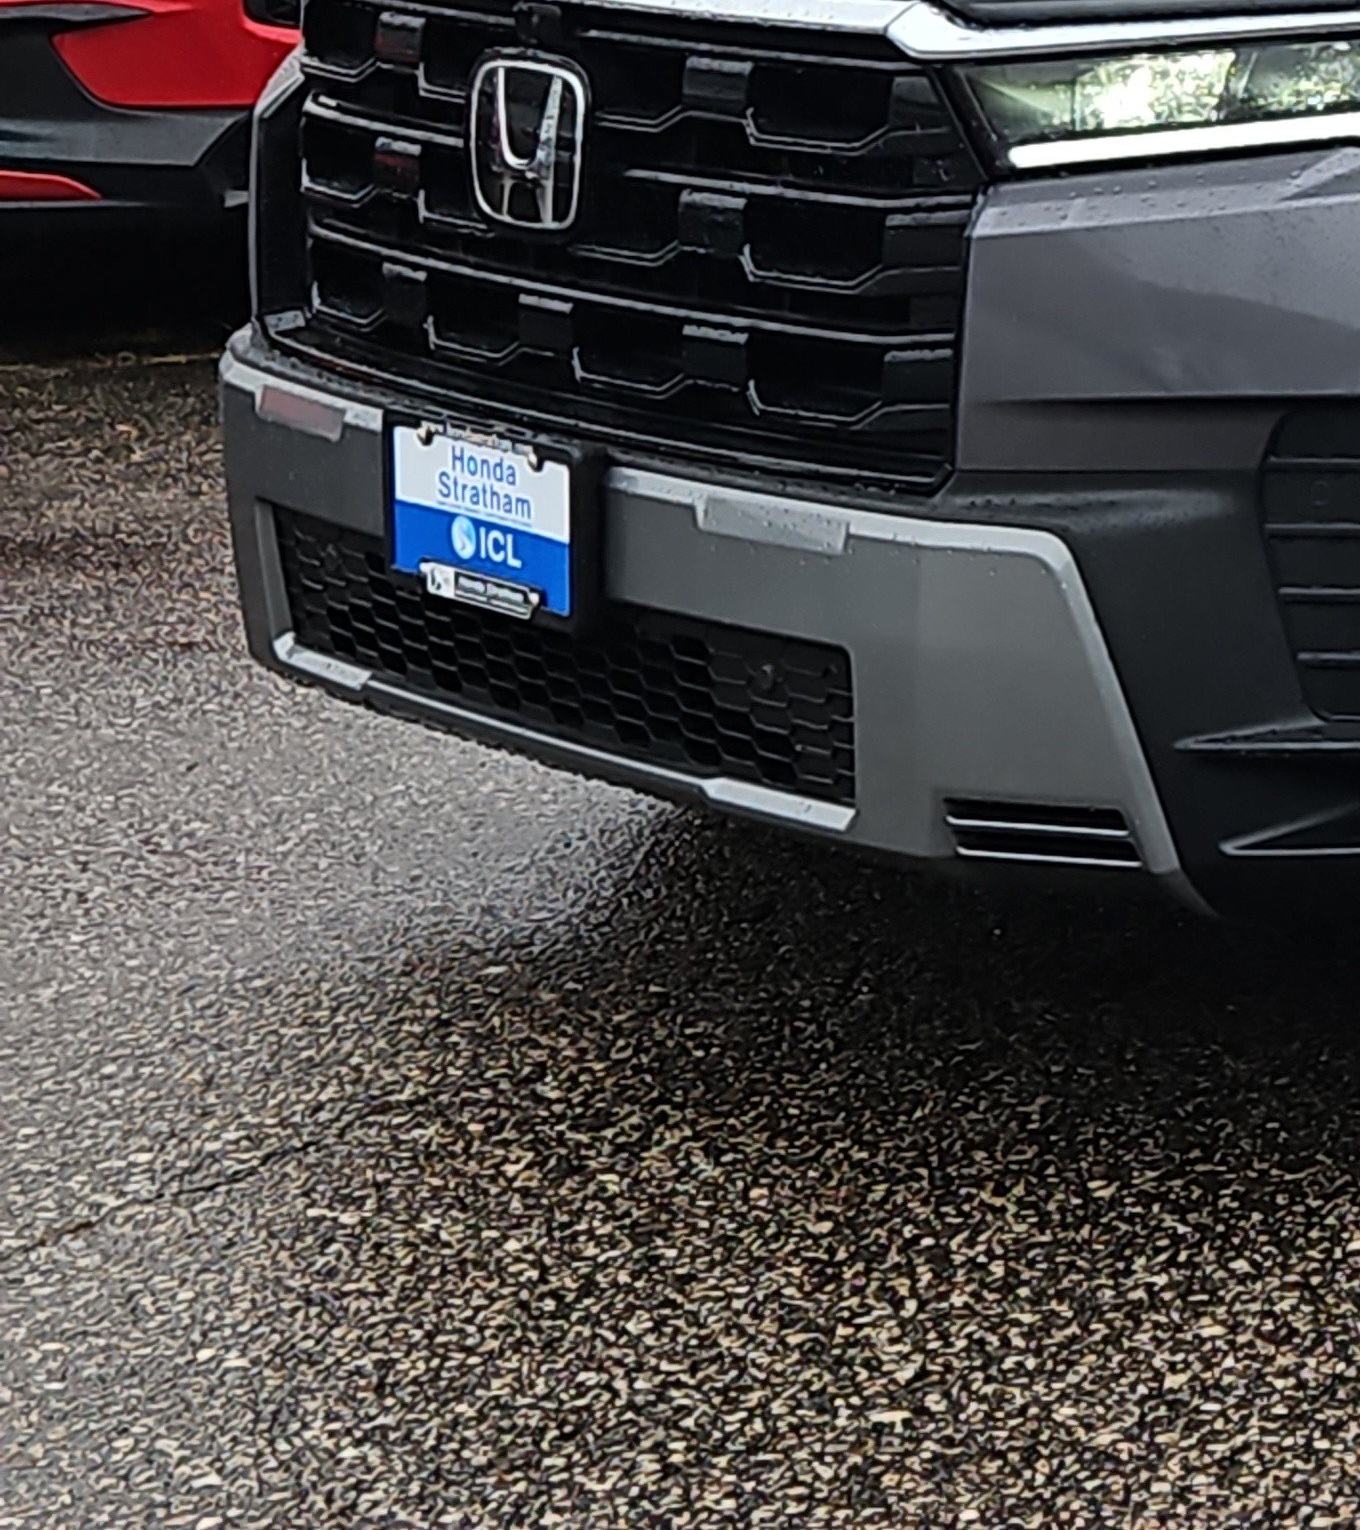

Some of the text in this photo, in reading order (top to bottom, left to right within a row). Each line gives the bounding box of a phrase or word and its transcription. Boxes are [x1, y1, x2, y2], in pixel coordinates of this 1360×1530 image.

[452, 445, 516, 487] Honda
[437, 470, 532, 520] Stratham
[479, 526, 522, 569] ICL
